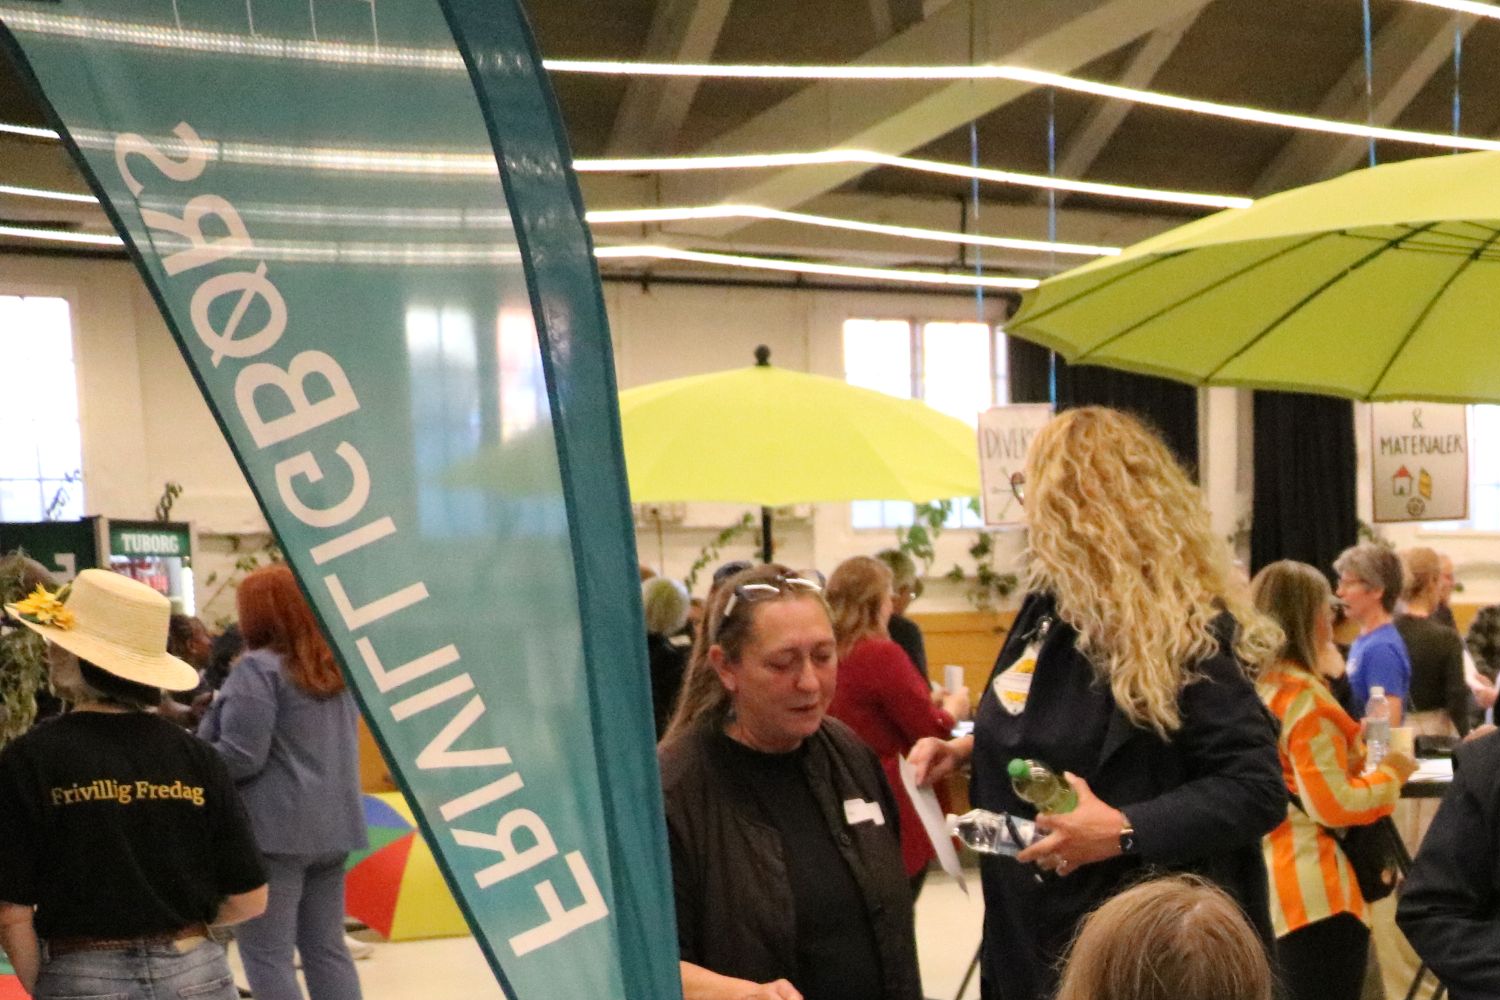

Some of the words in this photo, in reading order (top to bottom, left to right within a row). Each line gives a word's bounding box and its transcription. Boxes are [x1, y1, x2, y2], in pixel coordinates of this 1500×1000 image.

[1411, 407, 1423, 429] &
[1380, 433, 1464, 456] MATERIALER
[120, 533, 180, 554] TUBORG
[51, 779, 132, 804] Frivillig
[135, 780, 205, 806] Fredag
